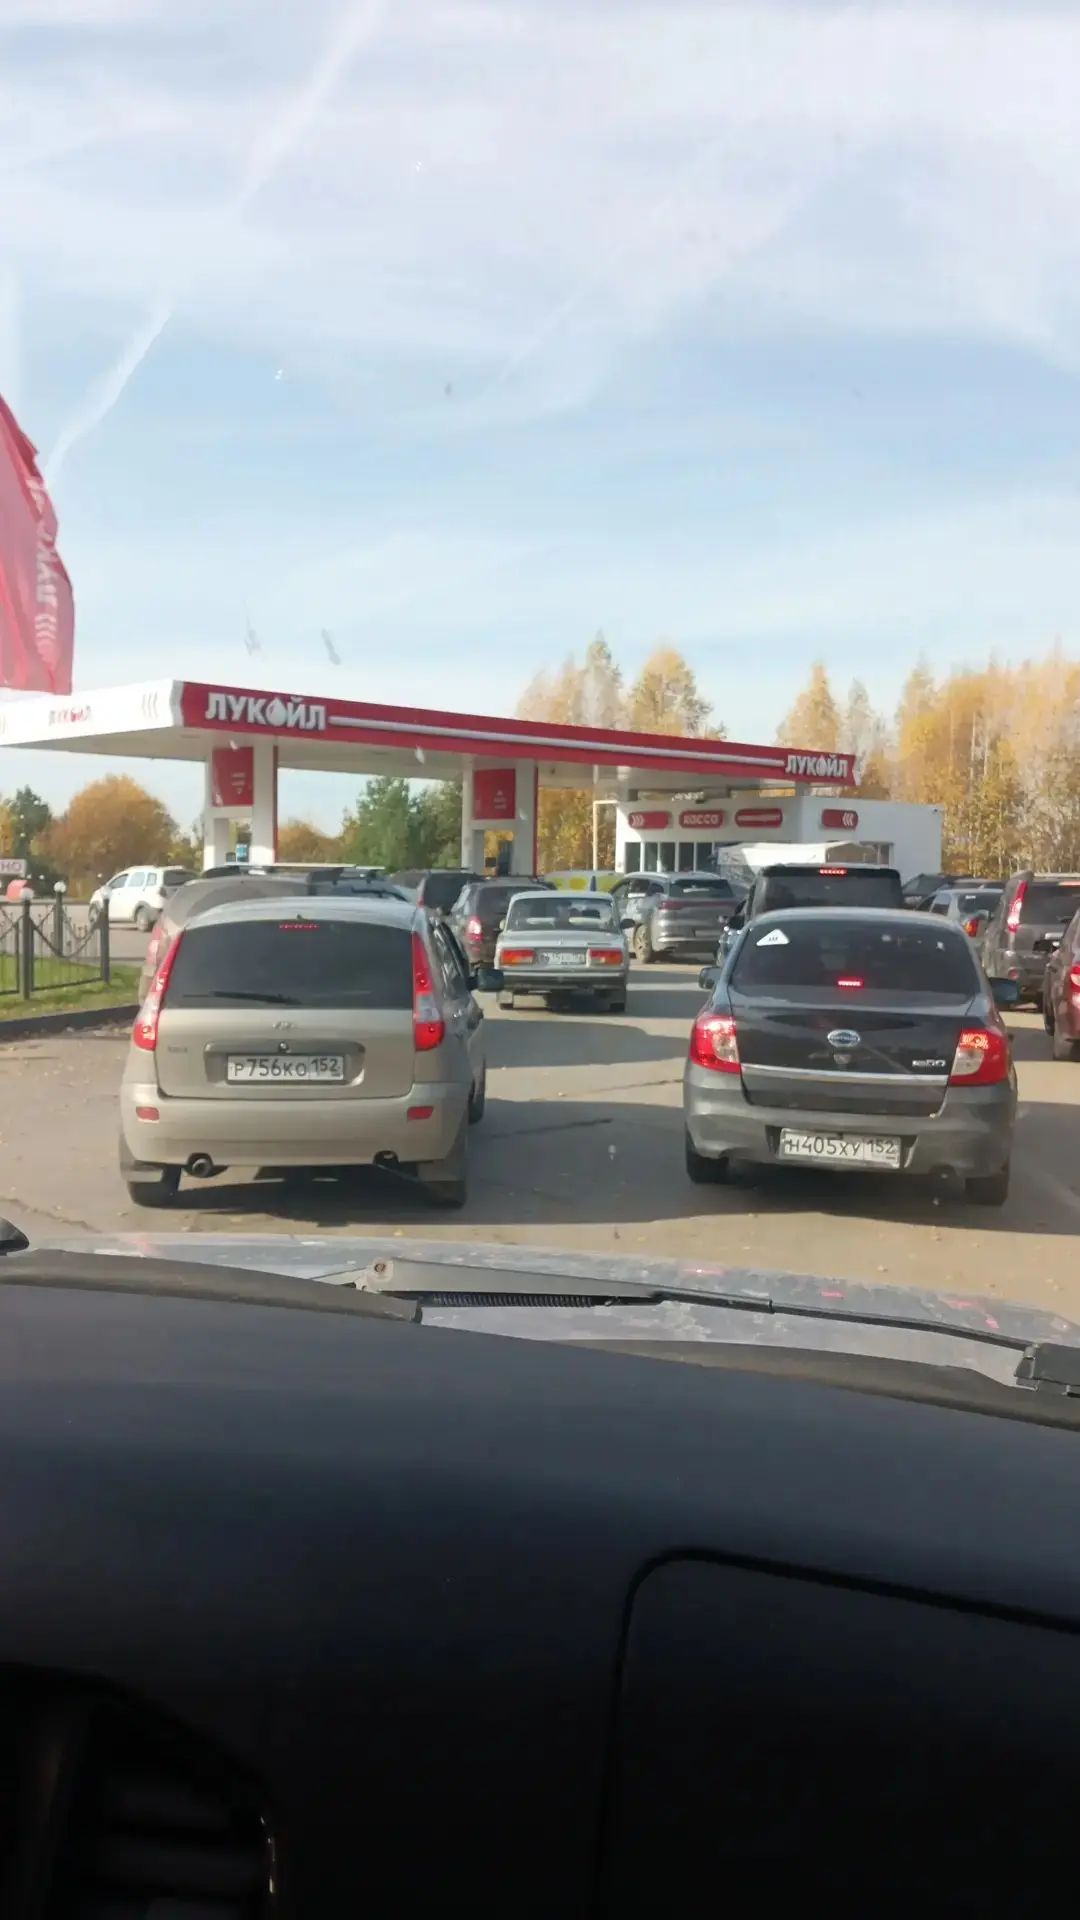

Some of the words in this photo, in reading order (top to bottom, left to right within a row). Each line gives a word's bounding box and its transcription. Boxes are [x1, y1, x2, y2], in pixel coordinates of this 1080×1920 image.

[205, 692, 326, 731] ЛУКОЙЛ
[784, 753, 849, 778] ЛУКОЙЛ
[0, 861, 22, 872] НО
[310, 1057, 338, 1073] 152
[866, 1139, 896, 1154] 152
